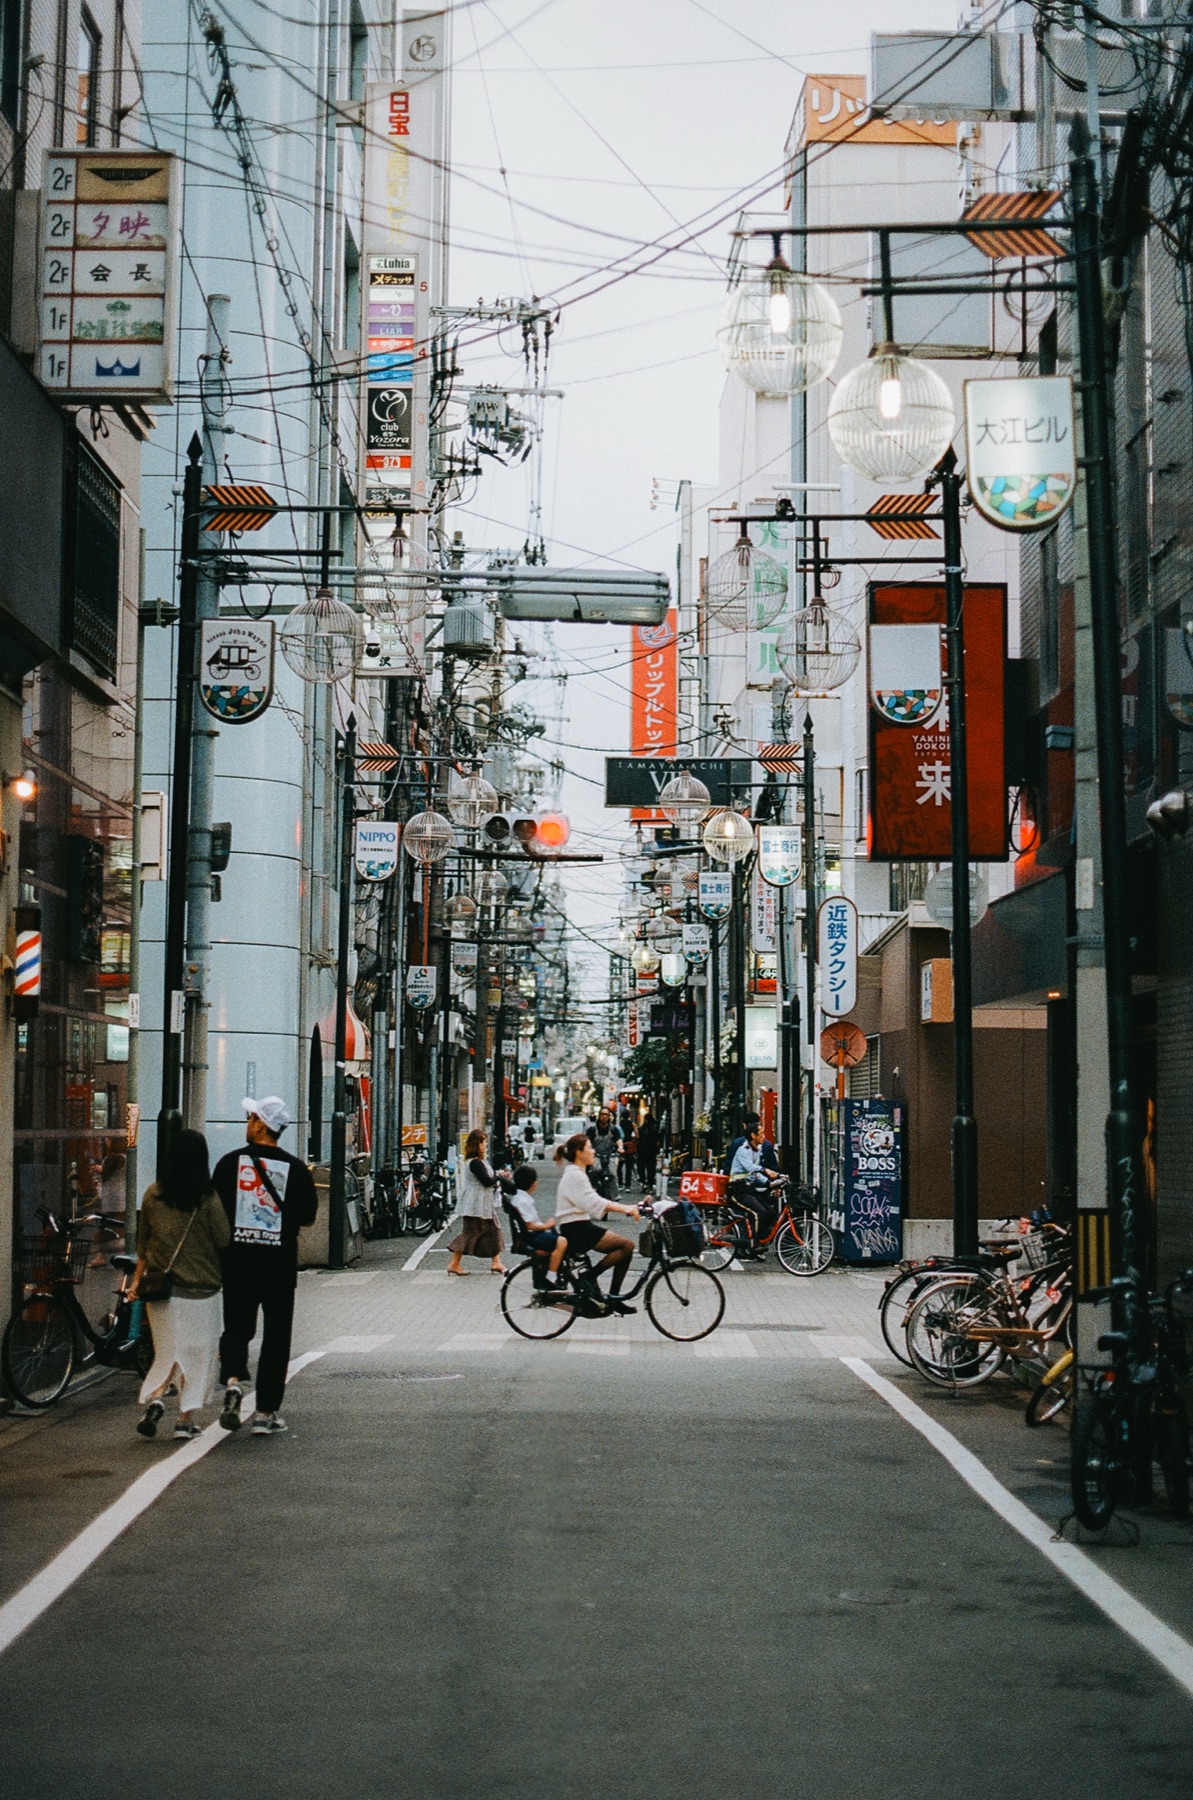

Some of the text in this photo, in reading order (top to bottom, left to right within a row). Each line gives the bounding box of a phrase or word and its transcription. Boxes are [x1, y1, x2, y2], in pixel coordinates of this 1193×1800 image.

[53, 167, 72, 191] 2F
[51, 213, 71, 237] 2F
[92, 210, 151, 240] 夕映
[49, 260, 69, 284] 2F
[90, 263, 151, 282] 会長
[420, 281, 427, 292] 5
[49, 307, 67, 330] 1F
[418, 347, 427, 357] 4
[48, 354, 66, 377] 1F
[380, 421, 399, 431] club
[976, 415, 1068, 446] 大江ビル
[370, 435, 410, 443] Yozora
[912, 735, 950, 743] YAKINI
[359, 831, 396, 843] NIPPO
[827, 905, 848, 1010] 近鉄タクシー
[863, 1120, 892, 1132] COFFEE
[858, 1157, 896, 1171] BOSS
